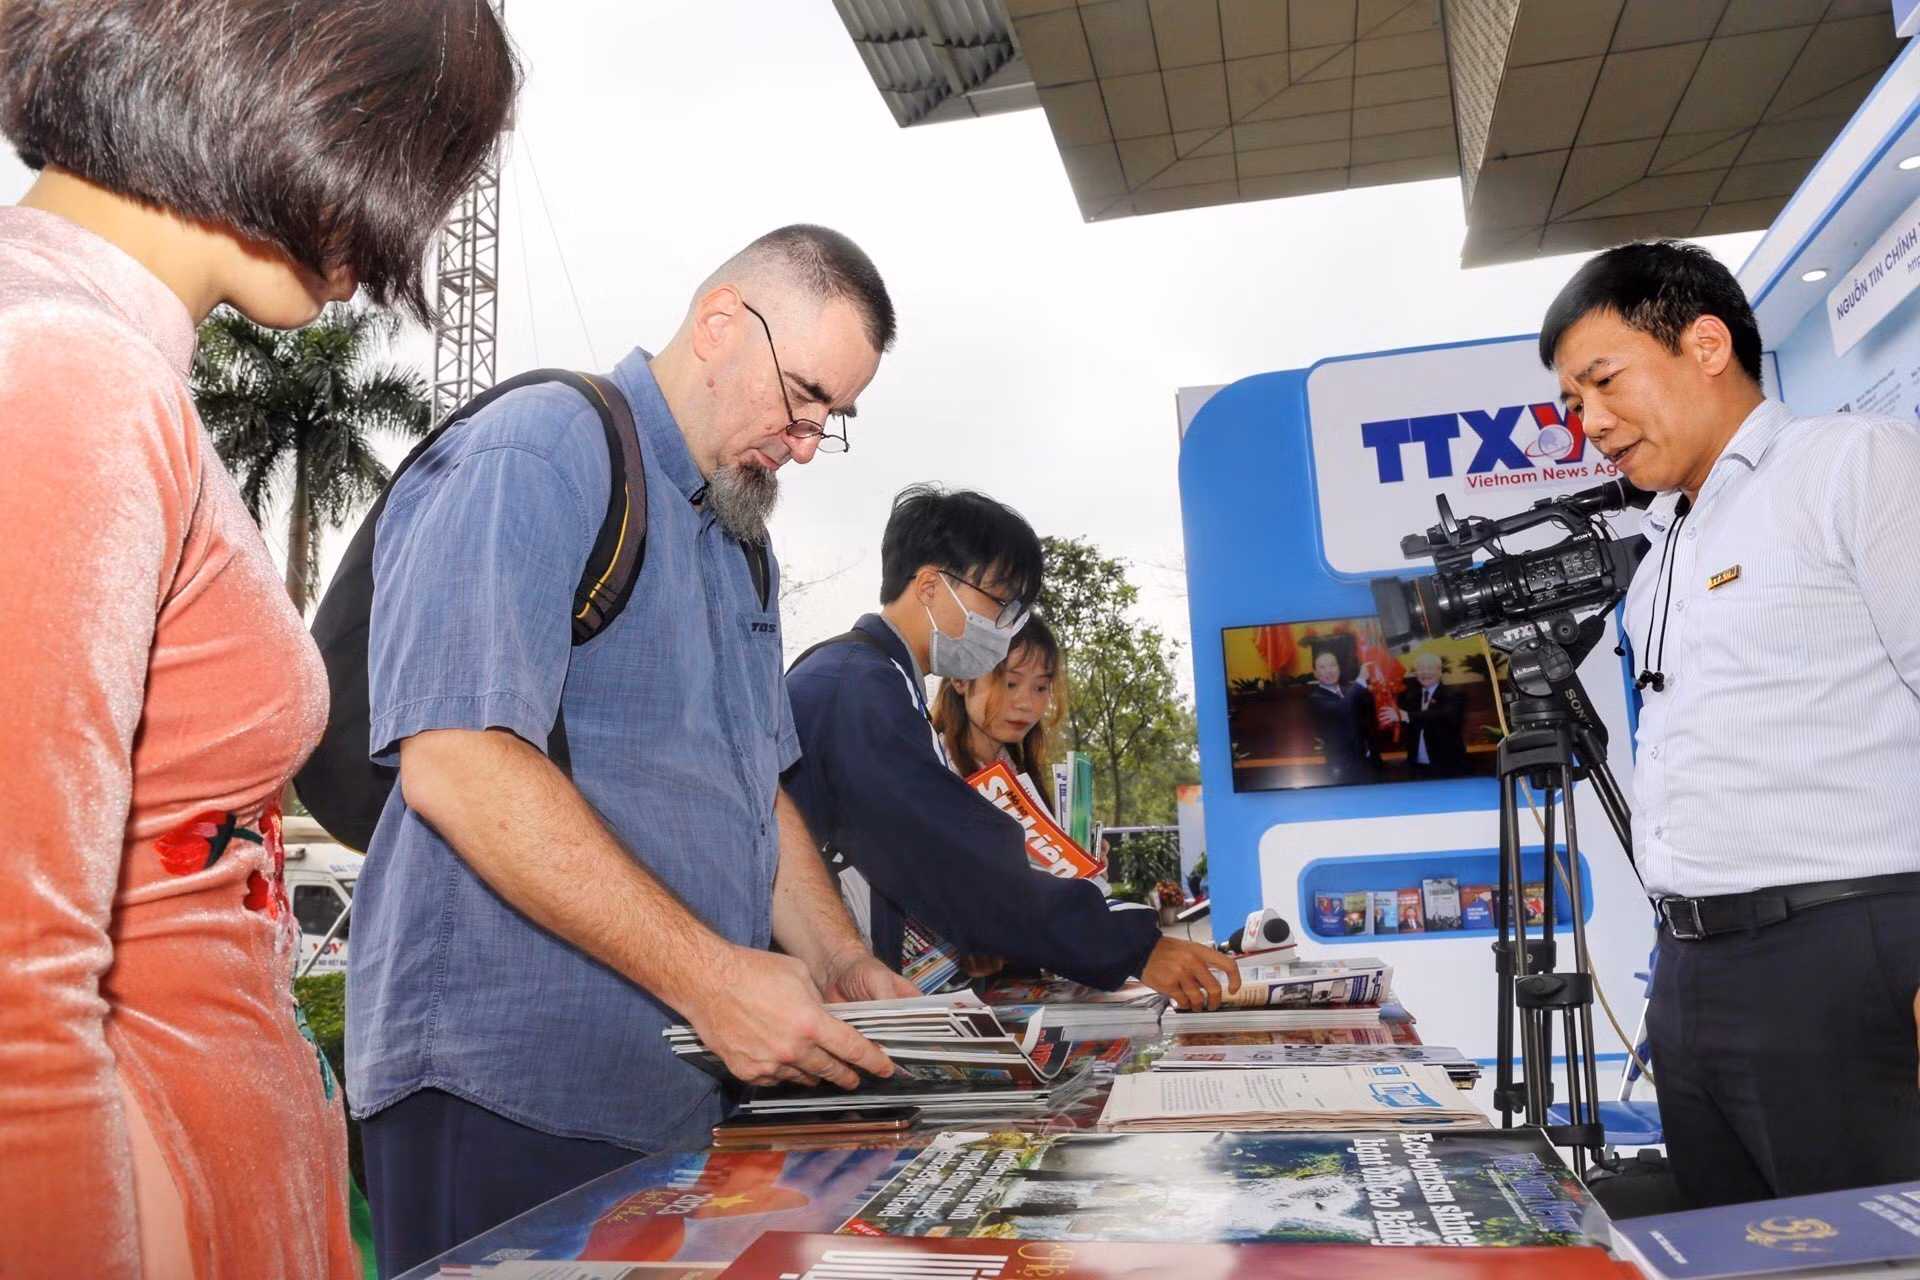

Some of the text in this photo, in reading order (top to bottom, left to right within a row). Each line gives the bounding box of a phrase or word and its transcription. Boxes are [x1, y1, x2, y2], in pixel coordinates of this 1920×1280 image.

[1836, 230, 1919, 320] NGUỒN TIN CHÍNH
[1361, 402, 1587, 483] TTXV
[1466, 471, 1537, 489] Vietnam
[1543, 465, 1588, 481] News
[1573, 530, 1593, 541] SONY
[1503, 620, 1551, 641] TTXN
[1347, 1138, 1392, 1164] light
[1398, 1133, 1458, 1202] Eco-tourism
[876, 1150, 957, 1217] embraces green travel
[912, 1150, 988, 1218] myriad ethnic cultures
[947, 1149, 1025, 1219] Northern province with
[1359, 1167, 1393, 1183] on
[1364, 1185, 1403, 1206] Cao
